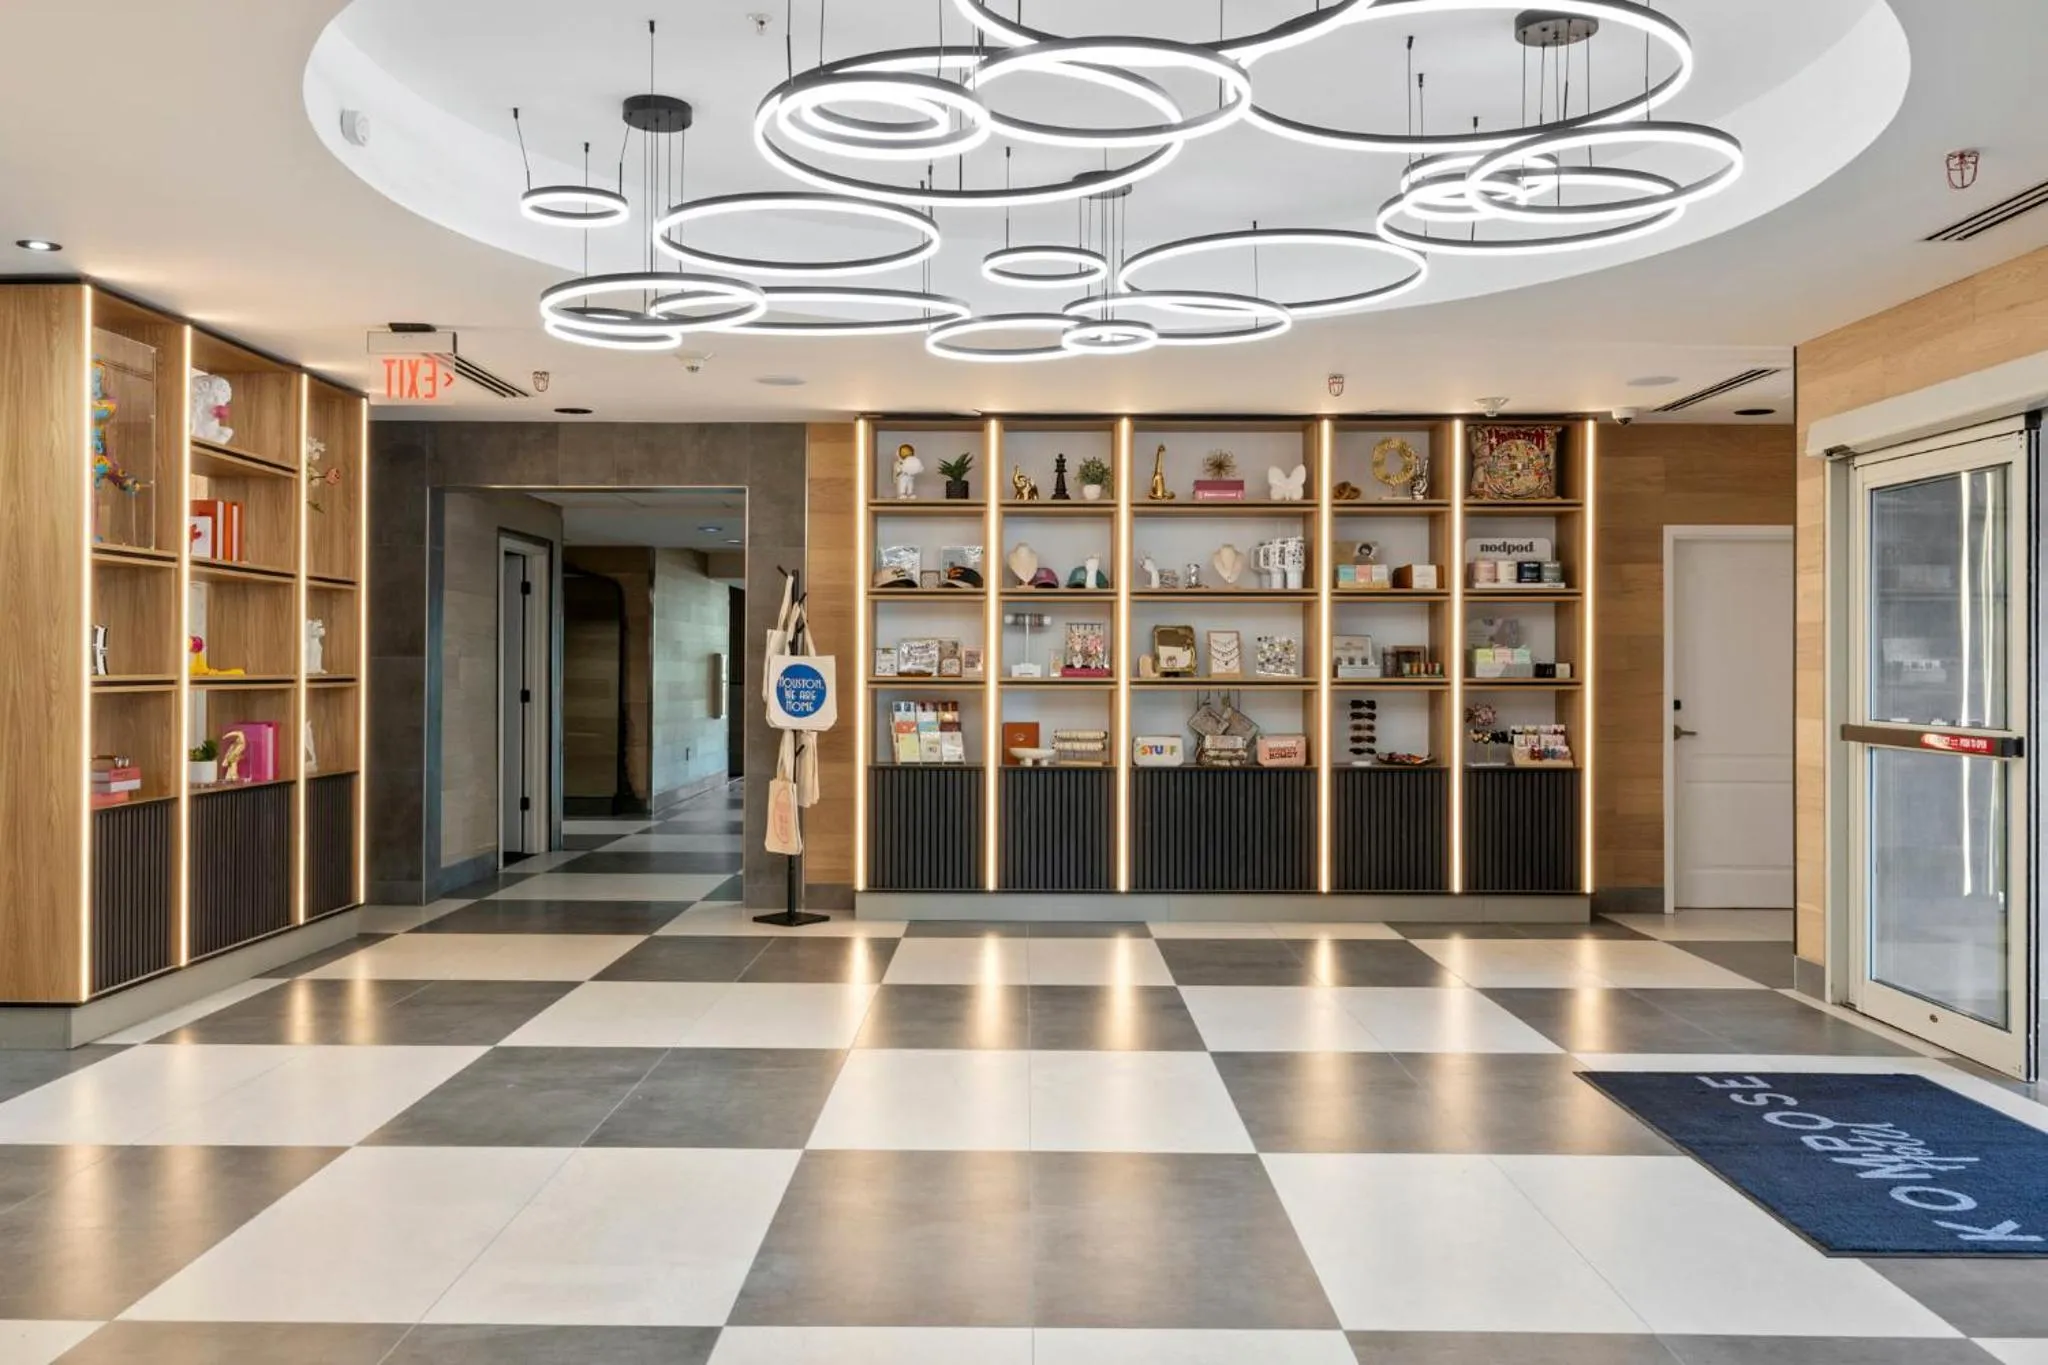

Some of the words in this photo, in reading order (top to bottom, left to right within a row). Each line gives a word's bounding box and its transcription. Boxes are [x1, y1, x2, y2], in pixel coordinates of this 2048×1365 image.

[1480, 541, 1534, 556] nodpod
[799, 690, 817, 700] ARE
[785, 700, 814, 712] HOME
[1696, 1075, 2045, 1242] KOMPOSE
